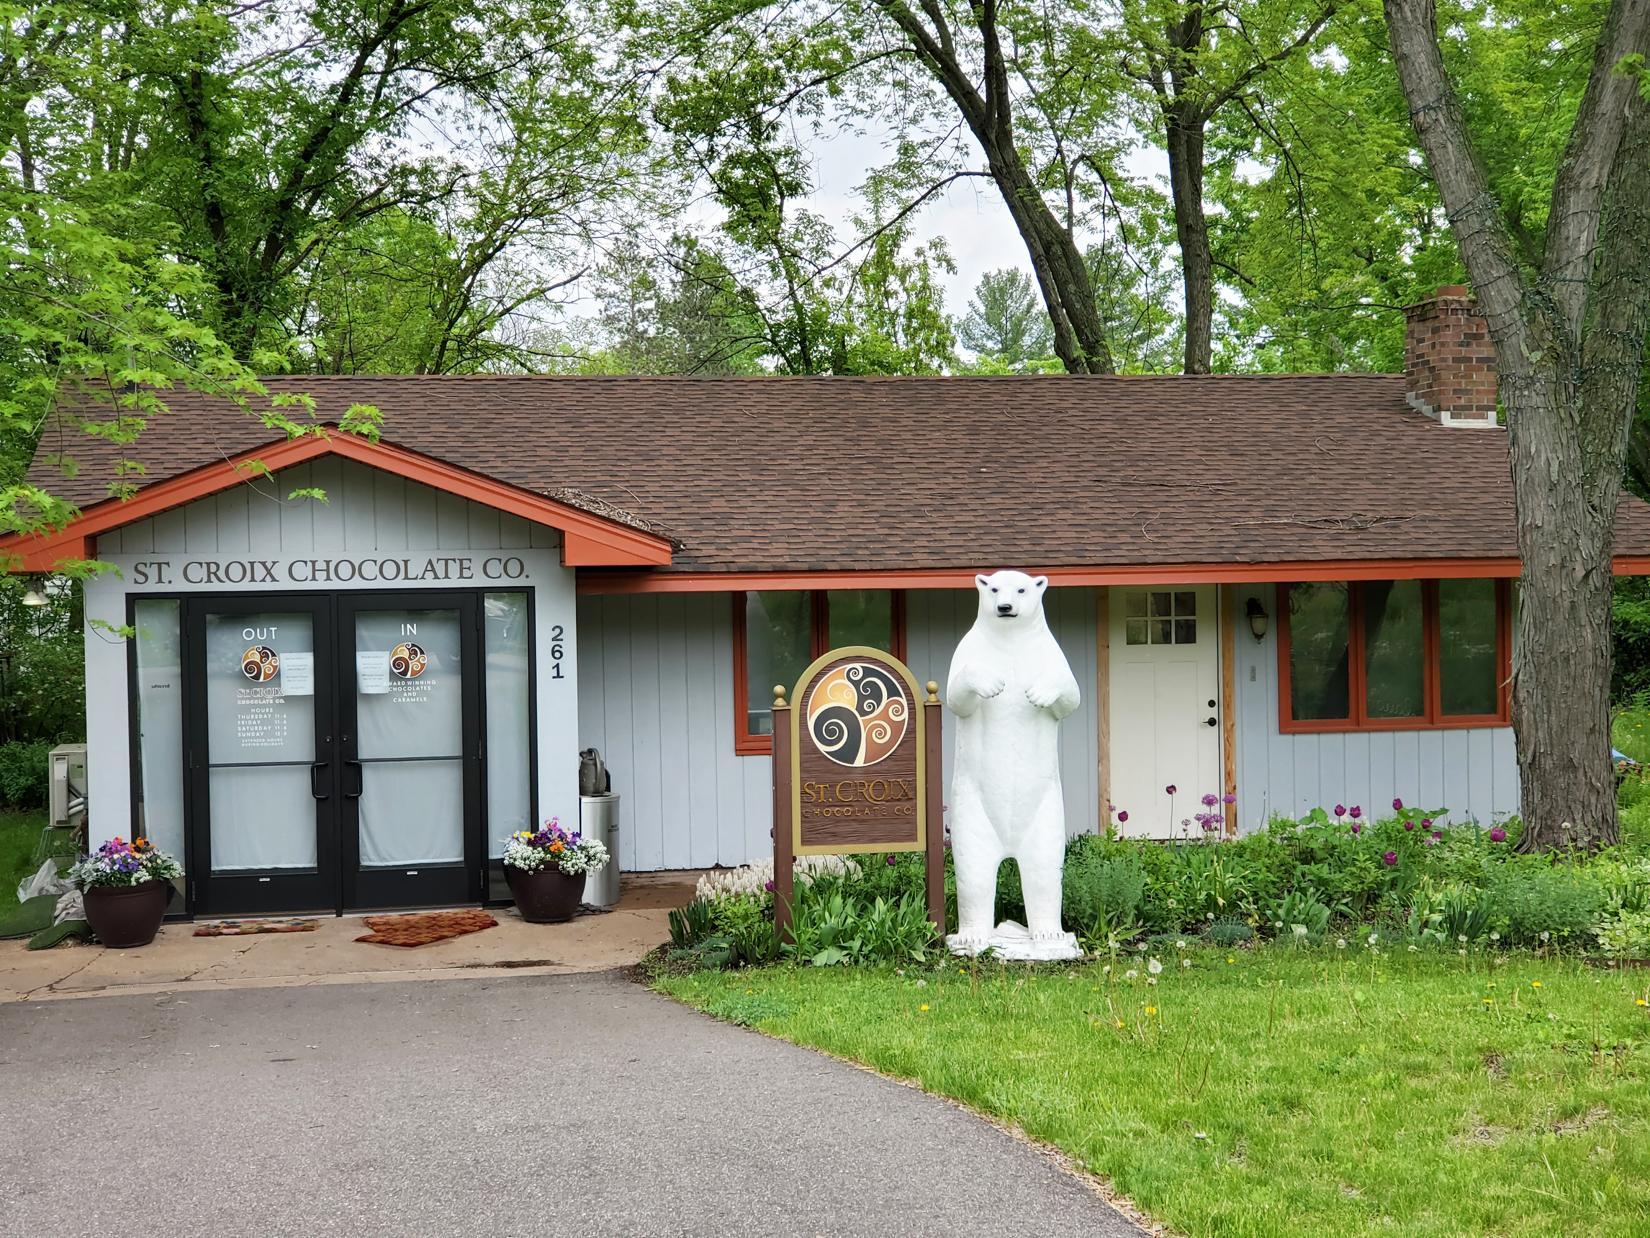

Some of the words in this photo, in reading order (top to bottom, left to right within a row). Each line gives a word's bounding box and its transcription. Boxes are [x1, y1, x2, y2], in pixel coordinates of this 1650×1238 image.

[133, 561, 172, 585] ST.
[182, 560, 280, 584] CROIX
[287, 557, 474, 582] CHOCOLATE
[482, 557, 530, 580] CO.
[242, 627, 278, 640] OUT
[401, 623, 417, 636] IN
[551, 625, 565, 679] 261
[835, 779, 913, 805] CROIX
[803, 806, 888, 818] CHOCOLATE
[894, 805, 915, 816] CO.
